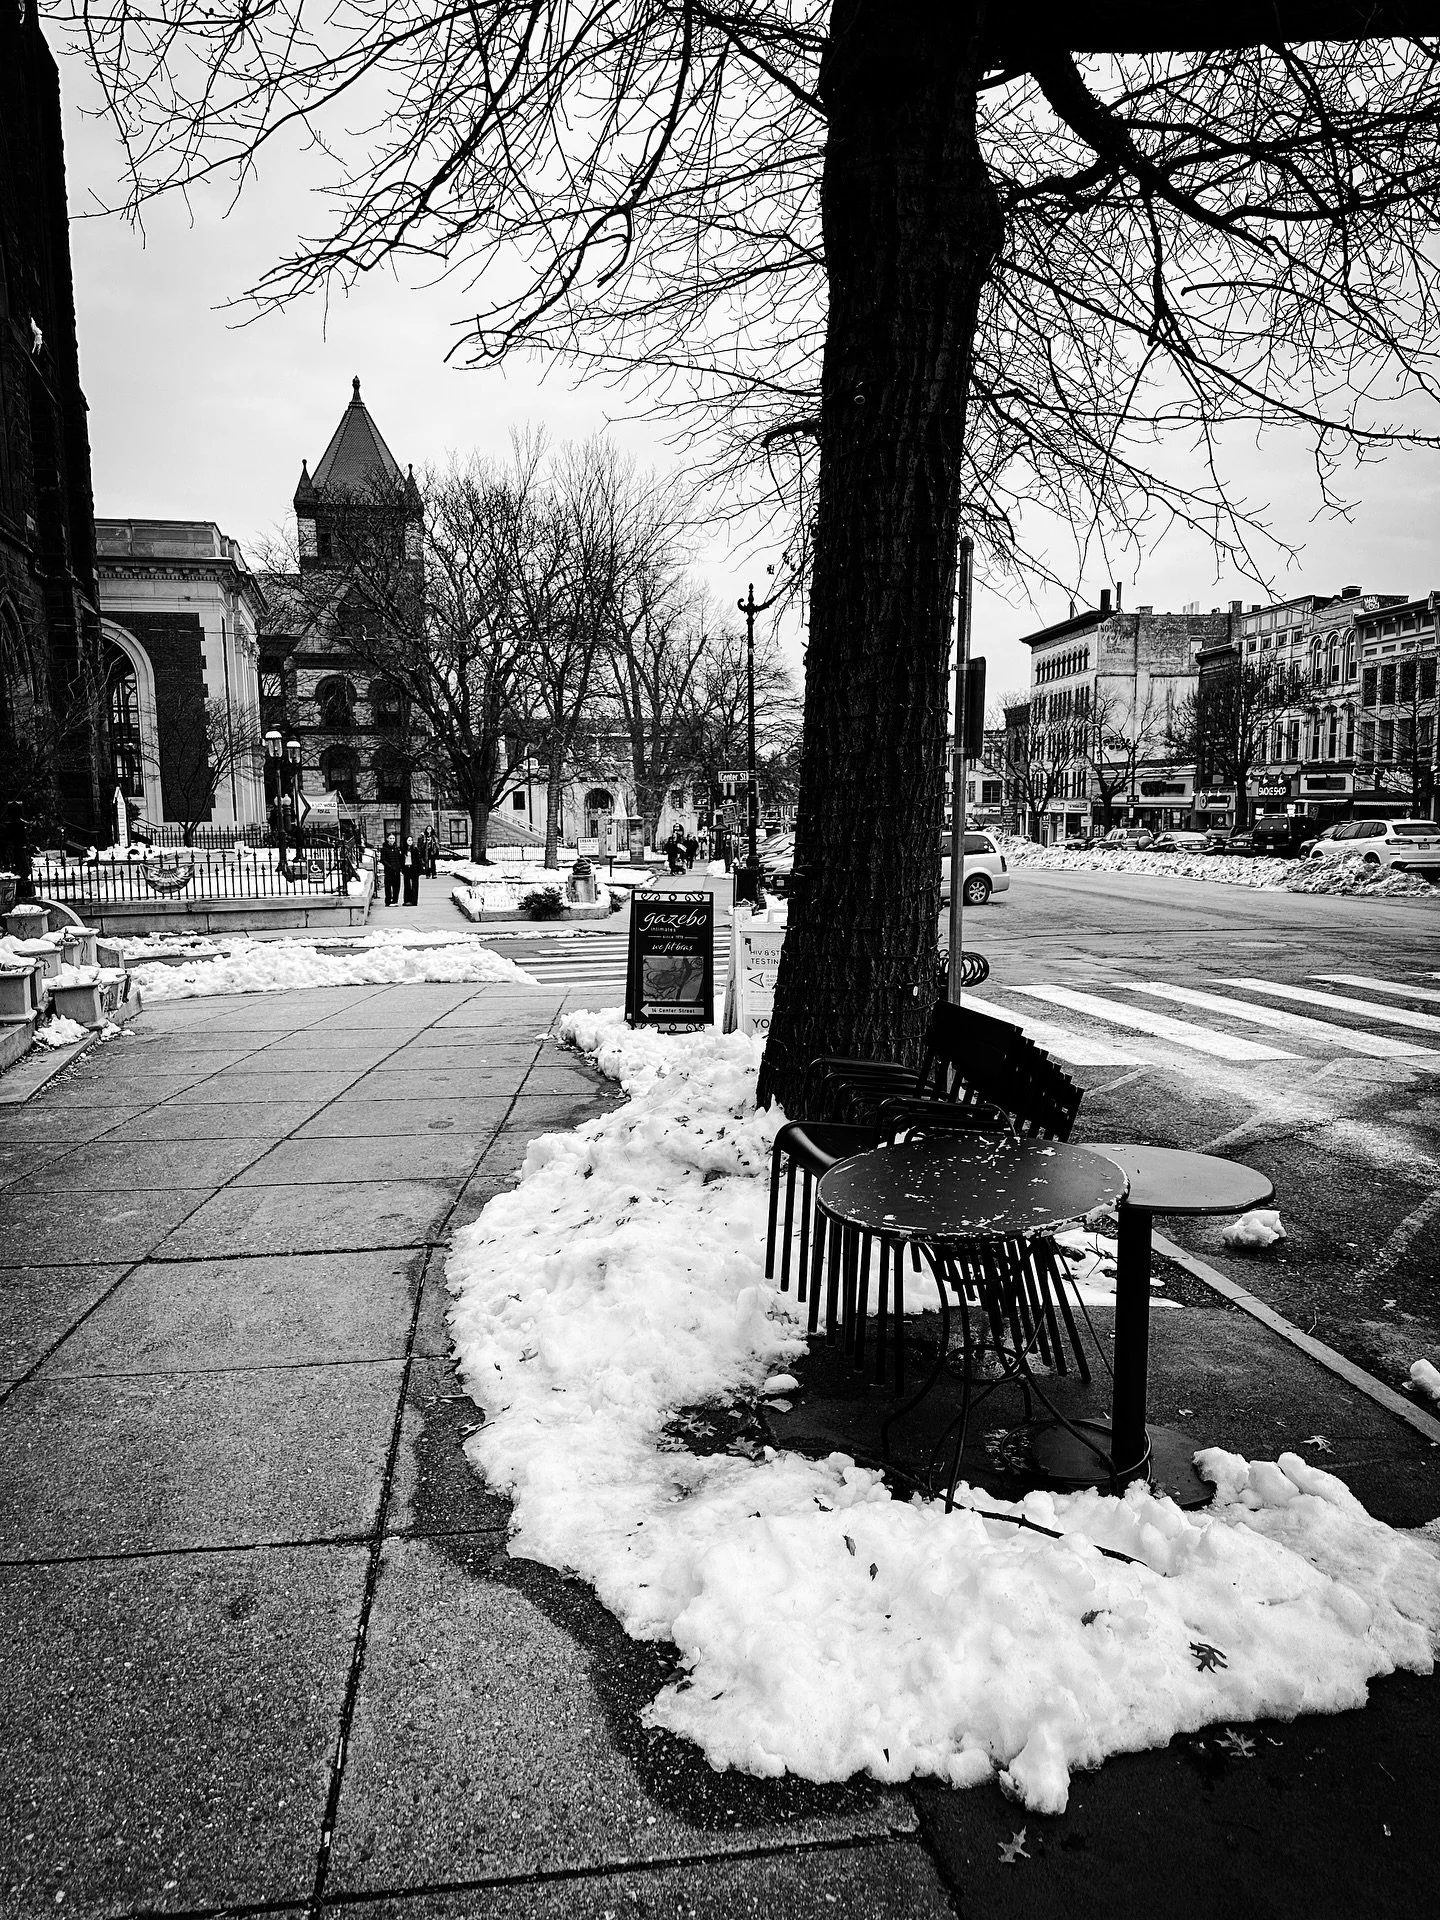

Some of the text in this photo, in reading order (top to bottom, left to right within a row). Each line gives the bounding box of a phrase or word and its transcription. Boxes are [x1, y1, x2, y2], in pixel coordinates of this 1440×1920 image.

[720, 773, 738, 781] Center
[639, 908, 707, 932] gazebo
[662, 941, 677, 953] fit
[675, 942, 693, 951] bras
[751, 957, 779, 965] TESTIN
[752, 1018, 770, 1028] YO
